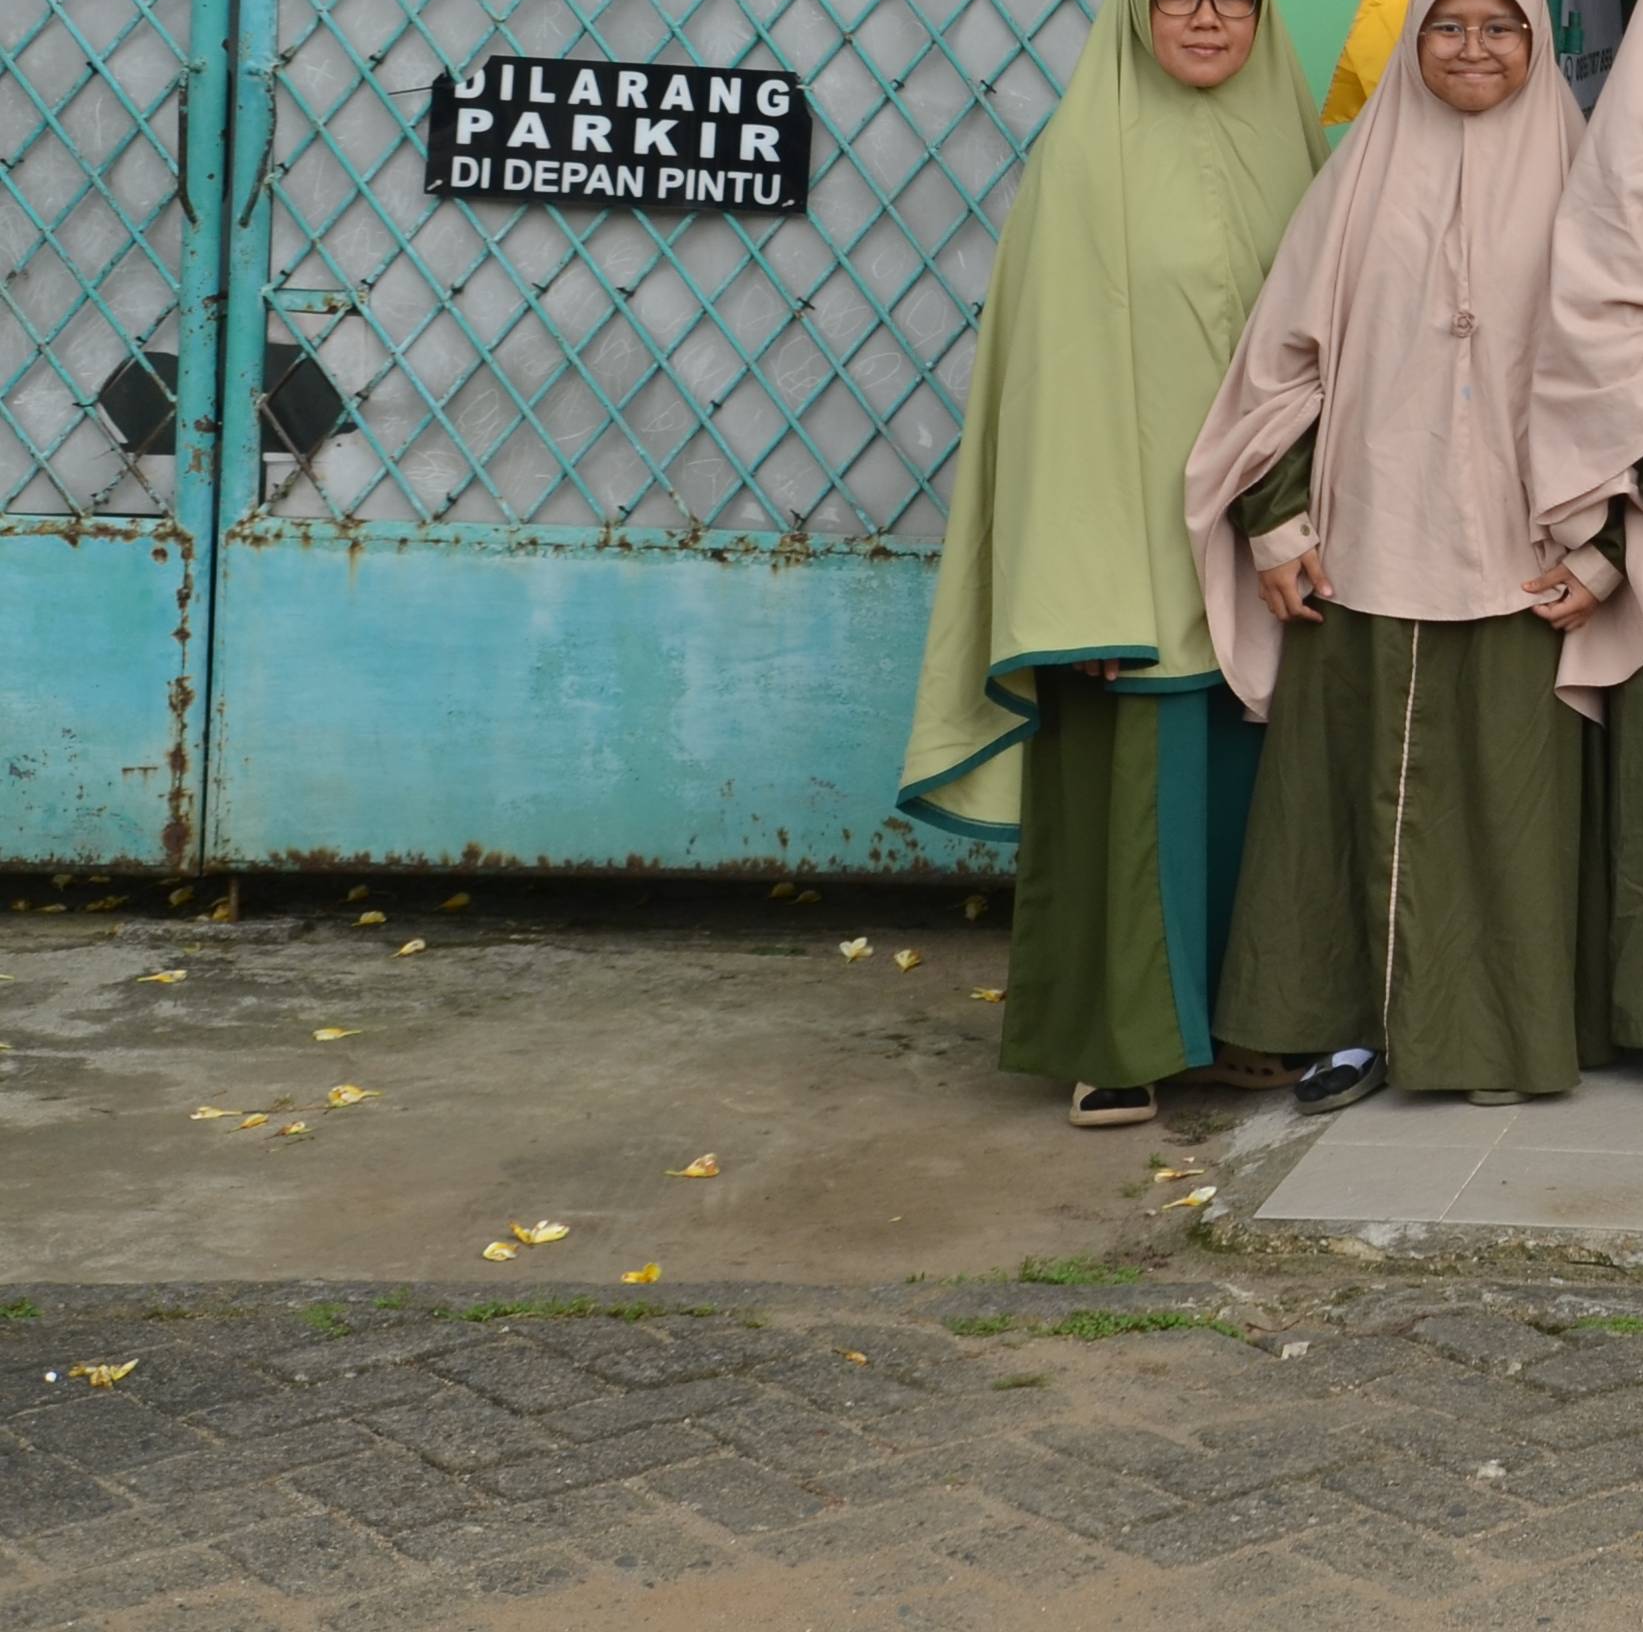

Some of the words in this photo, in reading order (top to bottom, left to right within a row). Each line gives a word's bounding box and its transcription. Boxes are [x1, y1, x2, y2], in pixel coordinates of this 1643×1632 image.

[453, 64, 790, 117] DILARANG
[455, 108, 781, 162] PARKIR
[450, 156, 491, 189] DI
[503, 158, 644, 197] DEPAN
[657, 166, 781, 205] PINTU
